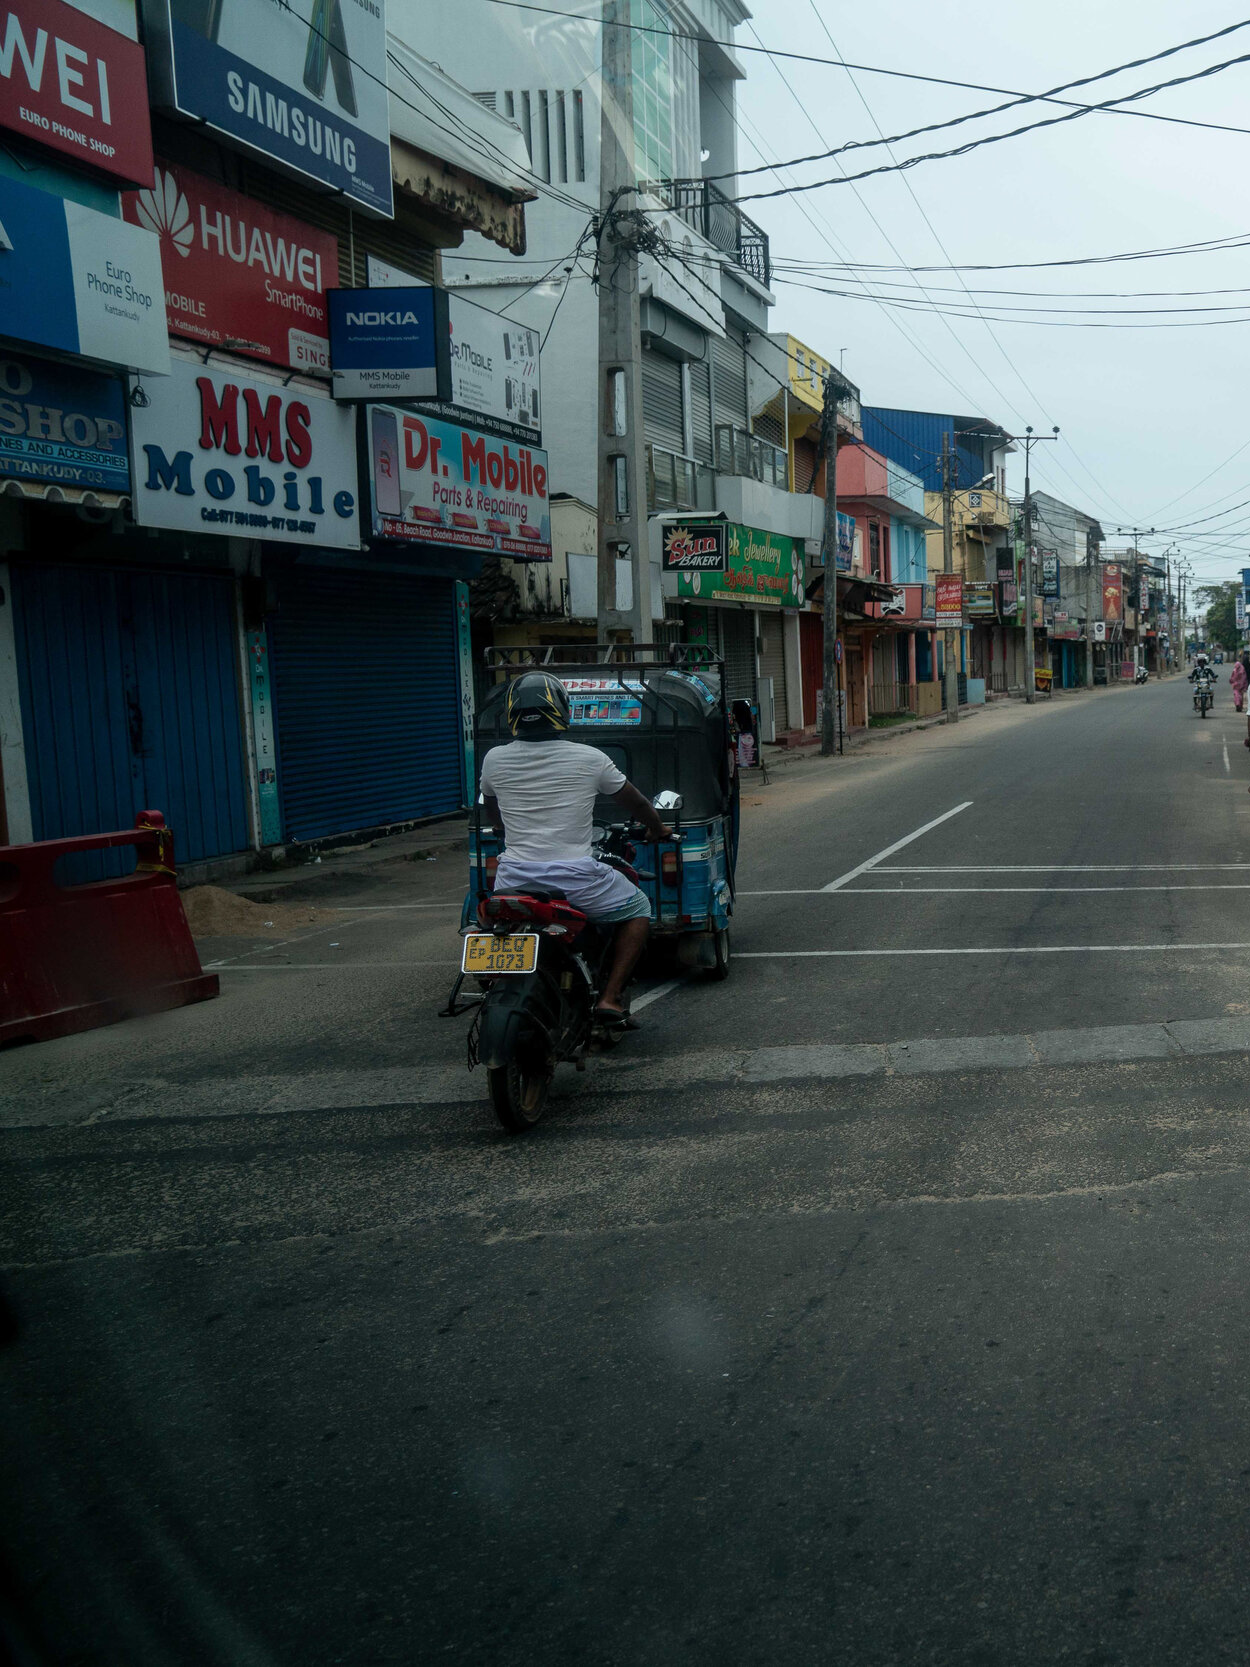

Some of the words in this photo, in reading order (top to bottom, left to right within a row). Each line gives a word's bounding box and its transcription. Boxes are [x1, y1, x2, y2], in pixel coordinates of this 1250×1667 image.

[20, 106, 49, 130] EURO
[52, 121, 88, 148] PHONE
[90, 138, 116, 158] SHOP
[226, 71, 357, 174] SAMSUNG
[200, 203, 322, 293] HUAWEI
[87, 272, 122, 299] Phone
[125, 285, 152, 311] Shop
[106, 261, 131, 283] Euro
[264, 279, 324, 321] SmartPhone
[346, 311, 419, 326] NOKIA
[360, 371, 380, 380] MMS
[382, 371, 410, 381] Mobile
[0, 397, 123, 451] SHOP
[196, 377, 313, 468] MMS
[28, 442, 53, 455] AND
[58, 447, 126, 467] ACCESSORIES
[402, 415, 449, 477] Dr.
[461, 432, 547, 498] Mobile
[143, 445, 355, 518] Mobile
[433, 482, 462, 507] Parts
[465, 489, 473, 508] &
[477, 491, 528, 523] Repairing
[668, 536, 717, 566] Sun
[679, 555, 722, 567] BAKERY
[744, 530, 781, 576] Jewellery
[469, 948, 486, 959] EP
